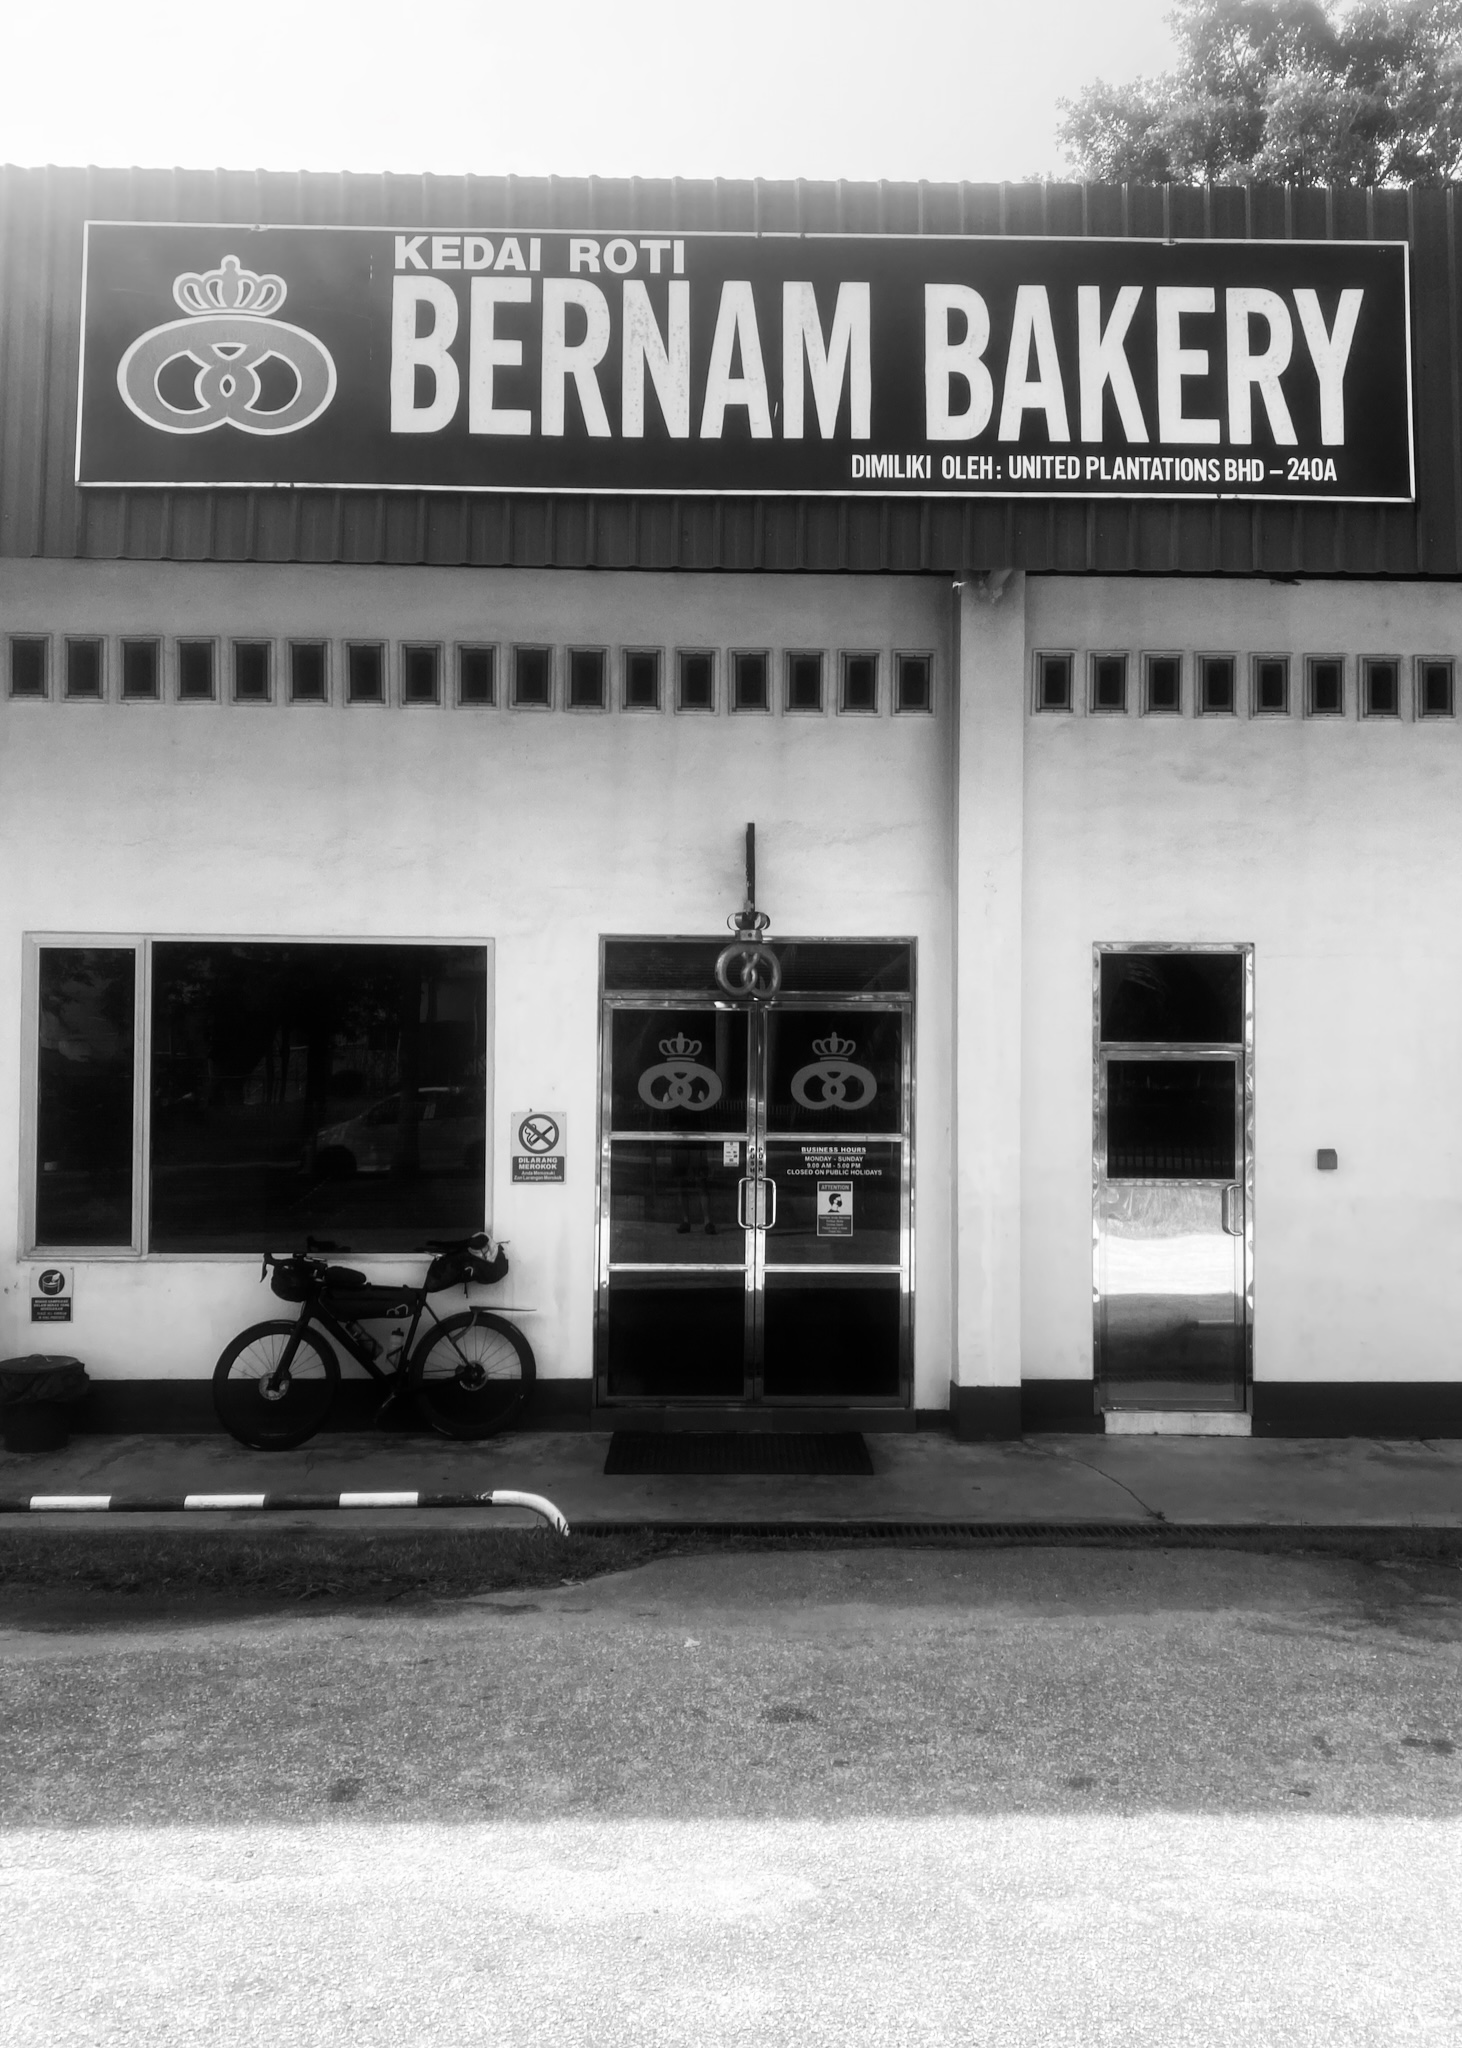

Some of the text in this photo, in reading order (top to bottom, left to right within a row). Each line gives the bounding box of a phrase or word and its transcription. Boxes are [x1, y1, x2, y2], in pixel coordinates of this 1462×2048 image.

[395, 236, 684, 274] KEDAI ROTI
[390, 275, 1364, 446] BERNAM BAKERY
[851, 454, 931, 478] DIMILIKI
[1008, 455, 1080, 480] UNITED
[1086, 456, 1220, 481] PLANTATIONS
[1225, 458, 1265, 482] BHD
[1287, 457, 1337, 481] 240A
